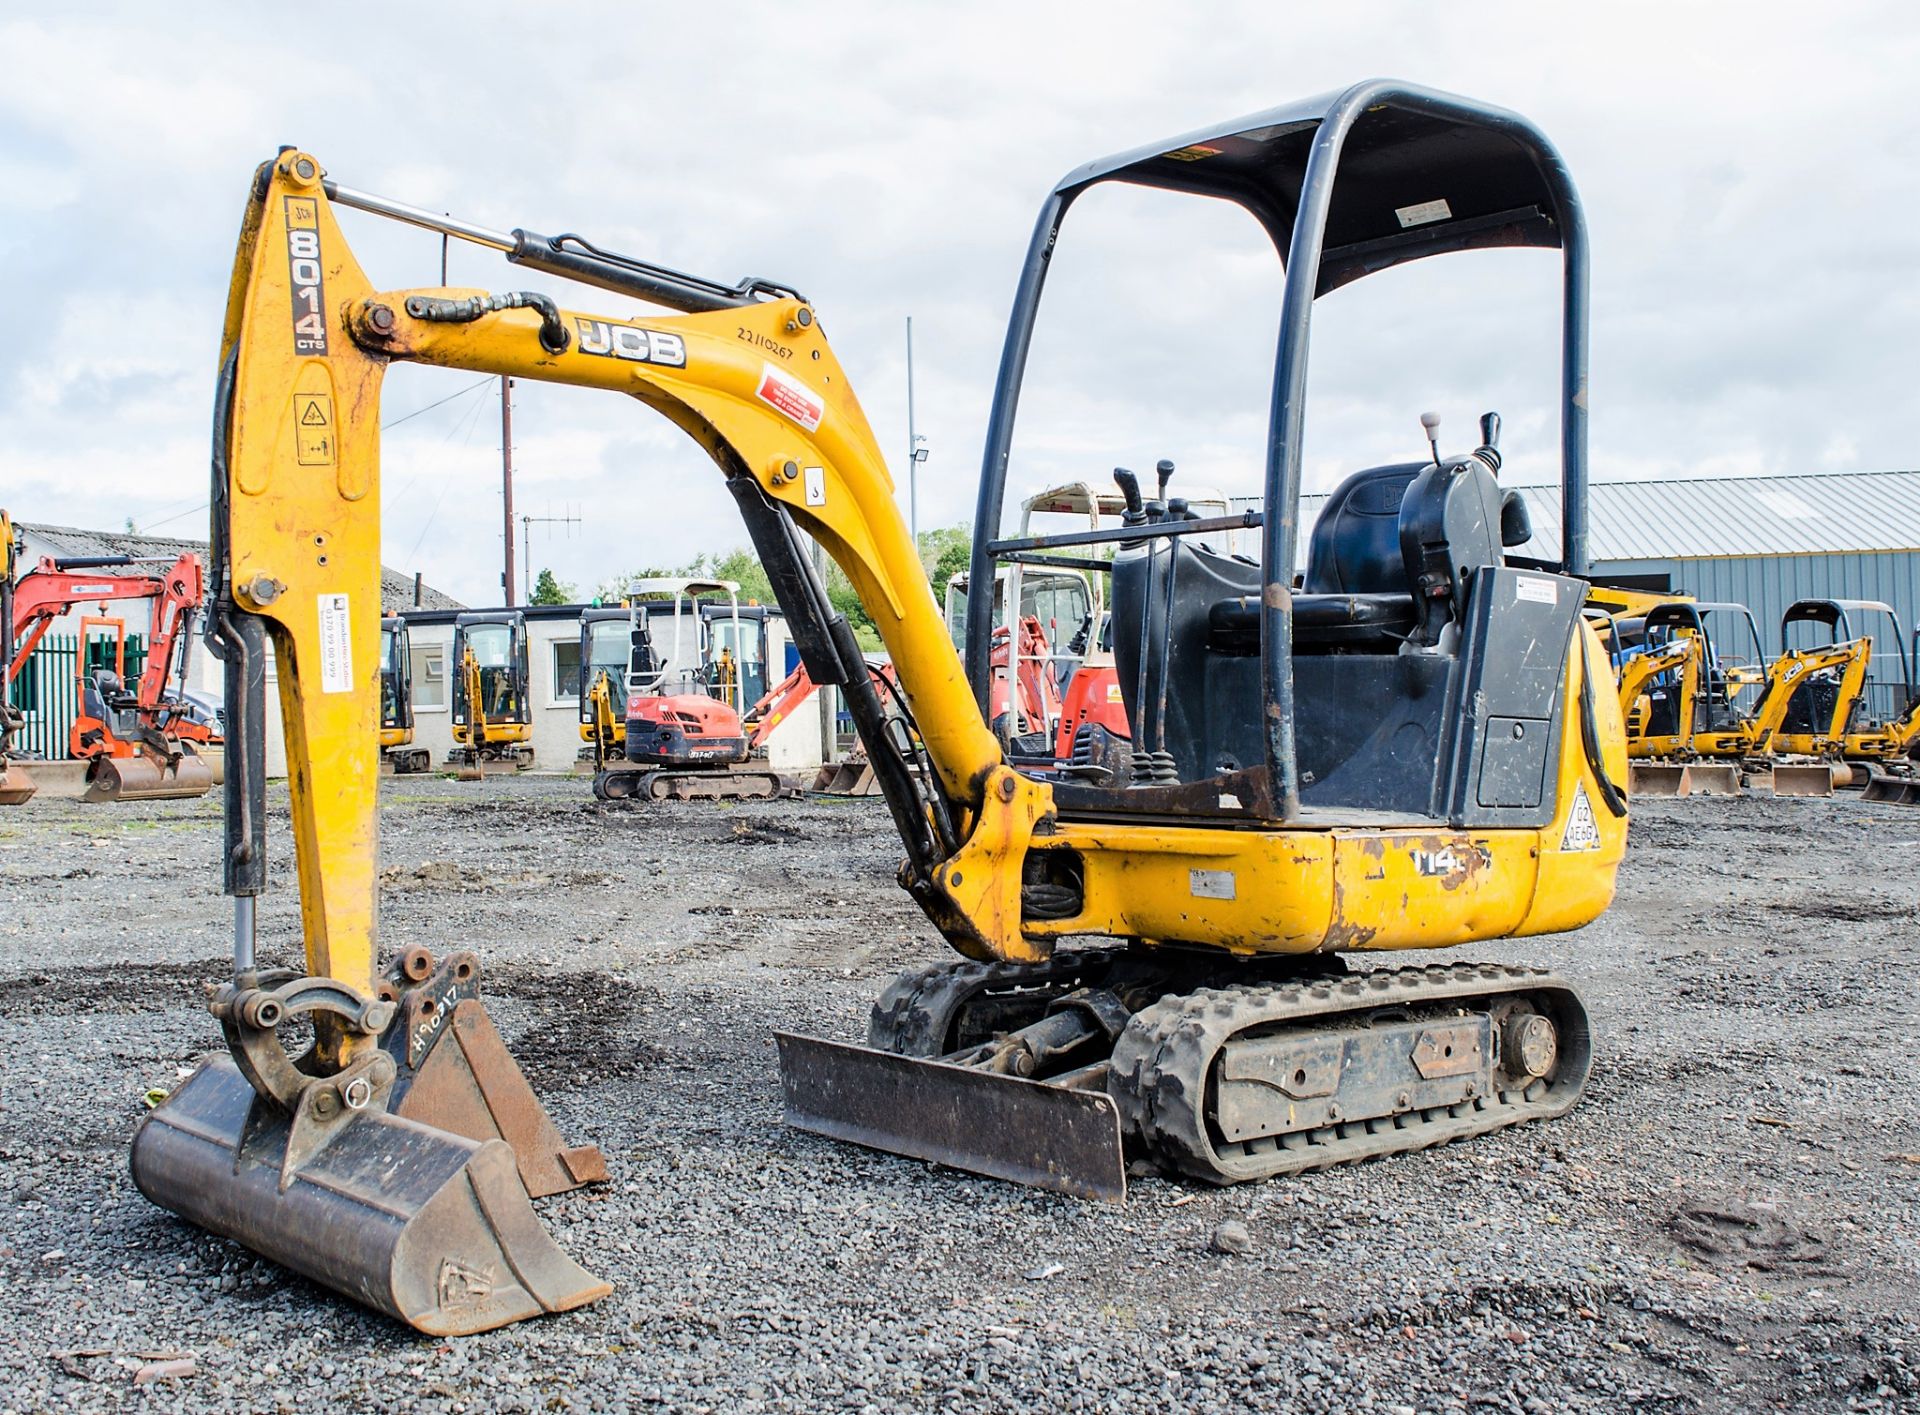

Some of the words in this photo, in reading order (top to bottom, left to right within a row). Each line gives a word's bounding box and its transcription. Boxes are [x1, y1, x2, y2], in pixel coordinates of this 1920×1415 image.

[290, 231, 324, 339] 8014
[297, 339, 325, 350] CTS
[581, 322, 686, 366] JCB
[737, 327, 794, 360] 22110267
[1783, 661, 1803, 683] JCB
